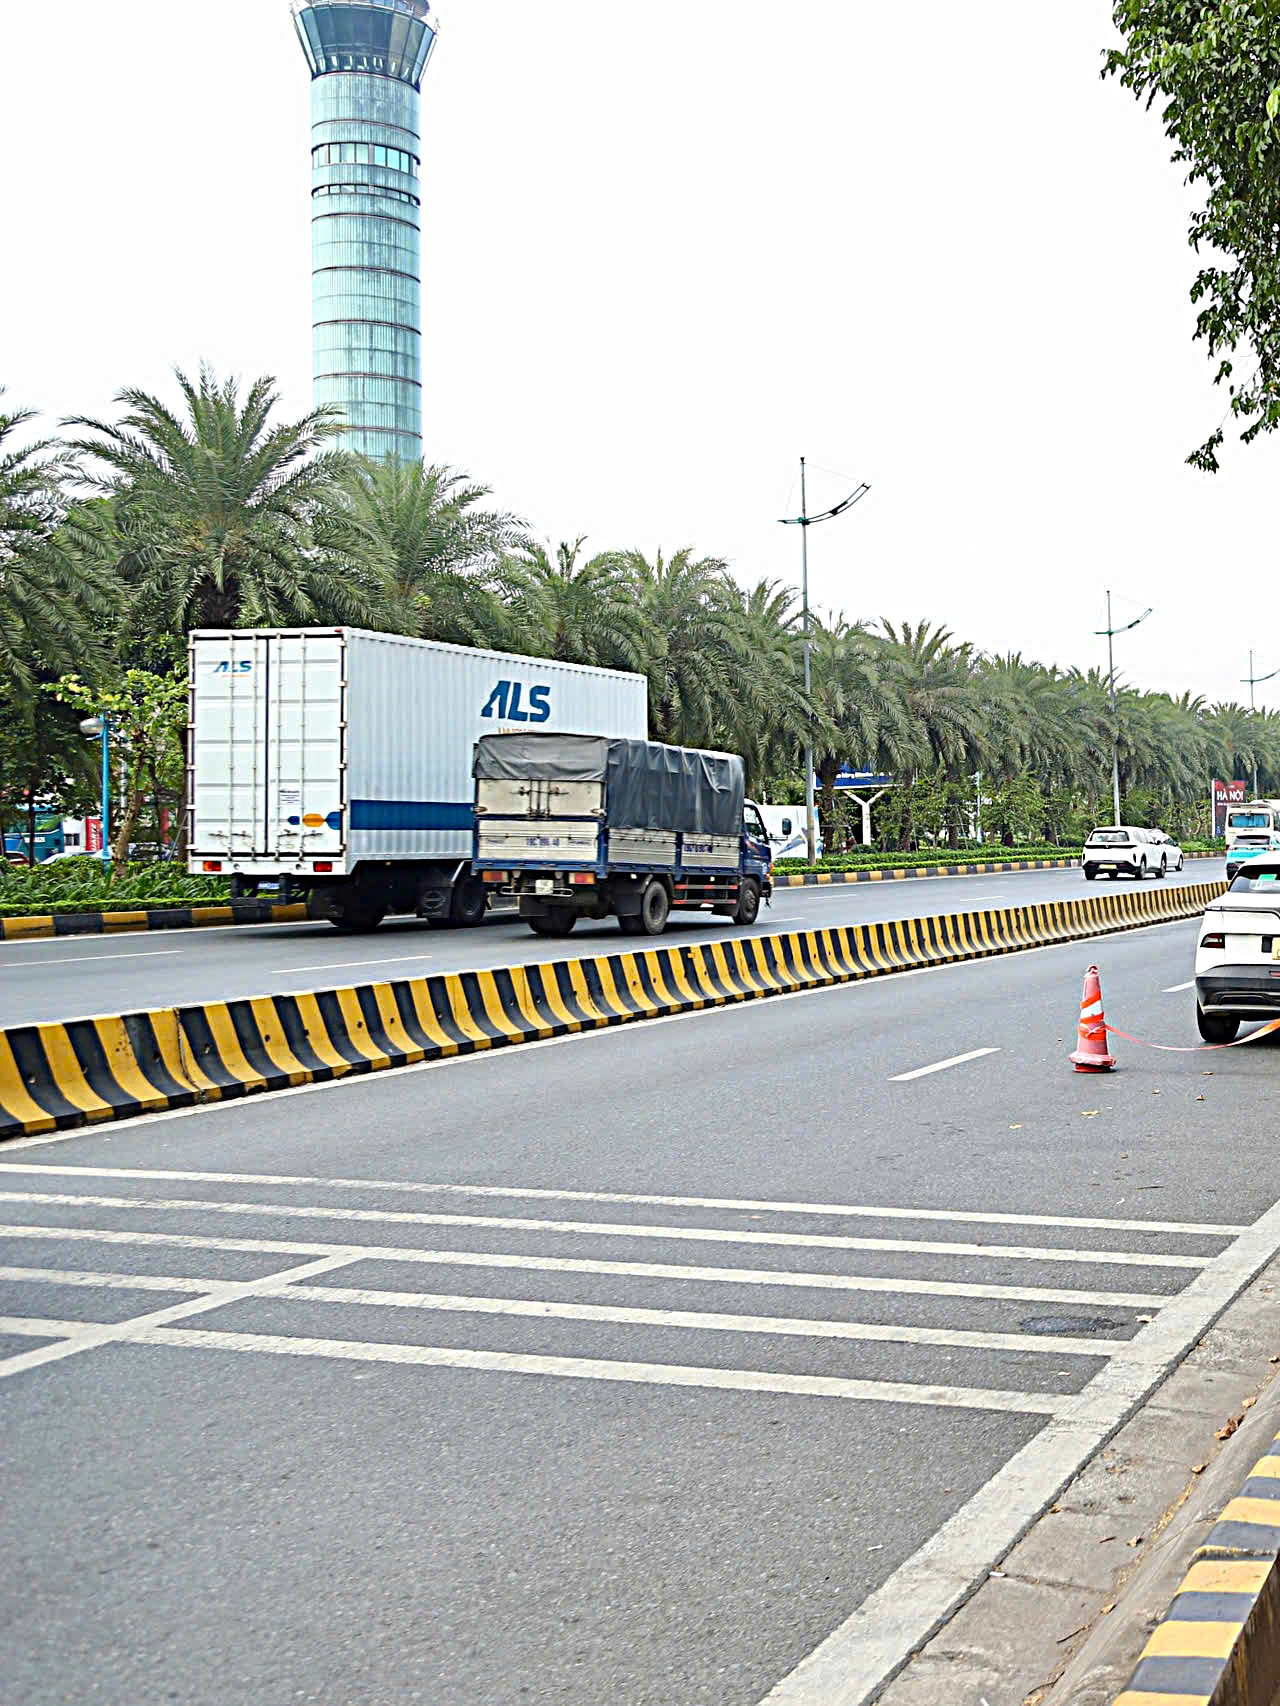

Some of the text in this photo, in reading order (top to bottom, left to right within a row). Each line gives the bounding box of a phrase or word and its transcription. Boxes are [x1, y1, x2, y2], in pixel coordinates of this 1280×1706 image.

[213, 660, 252, 673] ALS
[480, 680, 551, 723] ALS
[1216, 788, 1244, 801] HÀ NỘI
